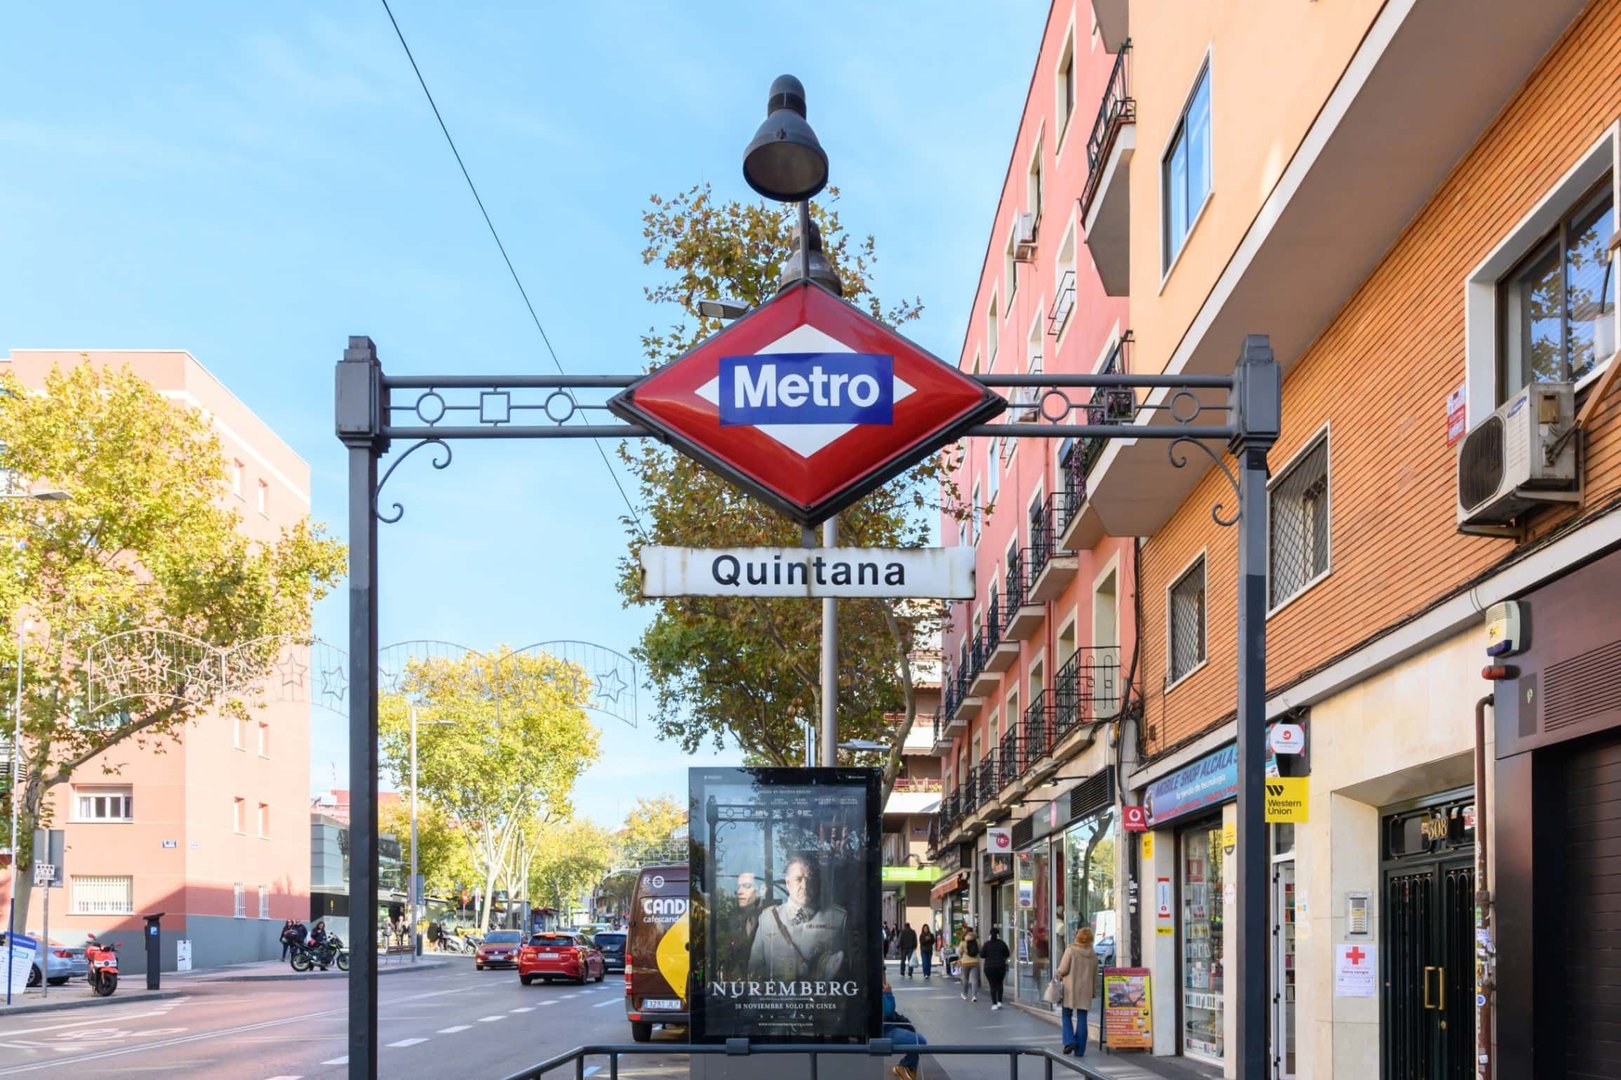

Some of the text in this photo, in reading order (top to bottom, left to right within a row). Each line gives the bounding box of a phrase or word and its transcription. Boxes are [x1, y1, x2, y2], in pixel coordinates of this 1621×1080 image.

[734, 364, 880, 409] Metro
[711, 554, 905, 587] Quintana
[1267, 799, 1302, 807] Western
[1267, 807, 1292, 815] Union
[1428, 817, 1448, 841] 308
[643, 898, 690, 915] CAND
